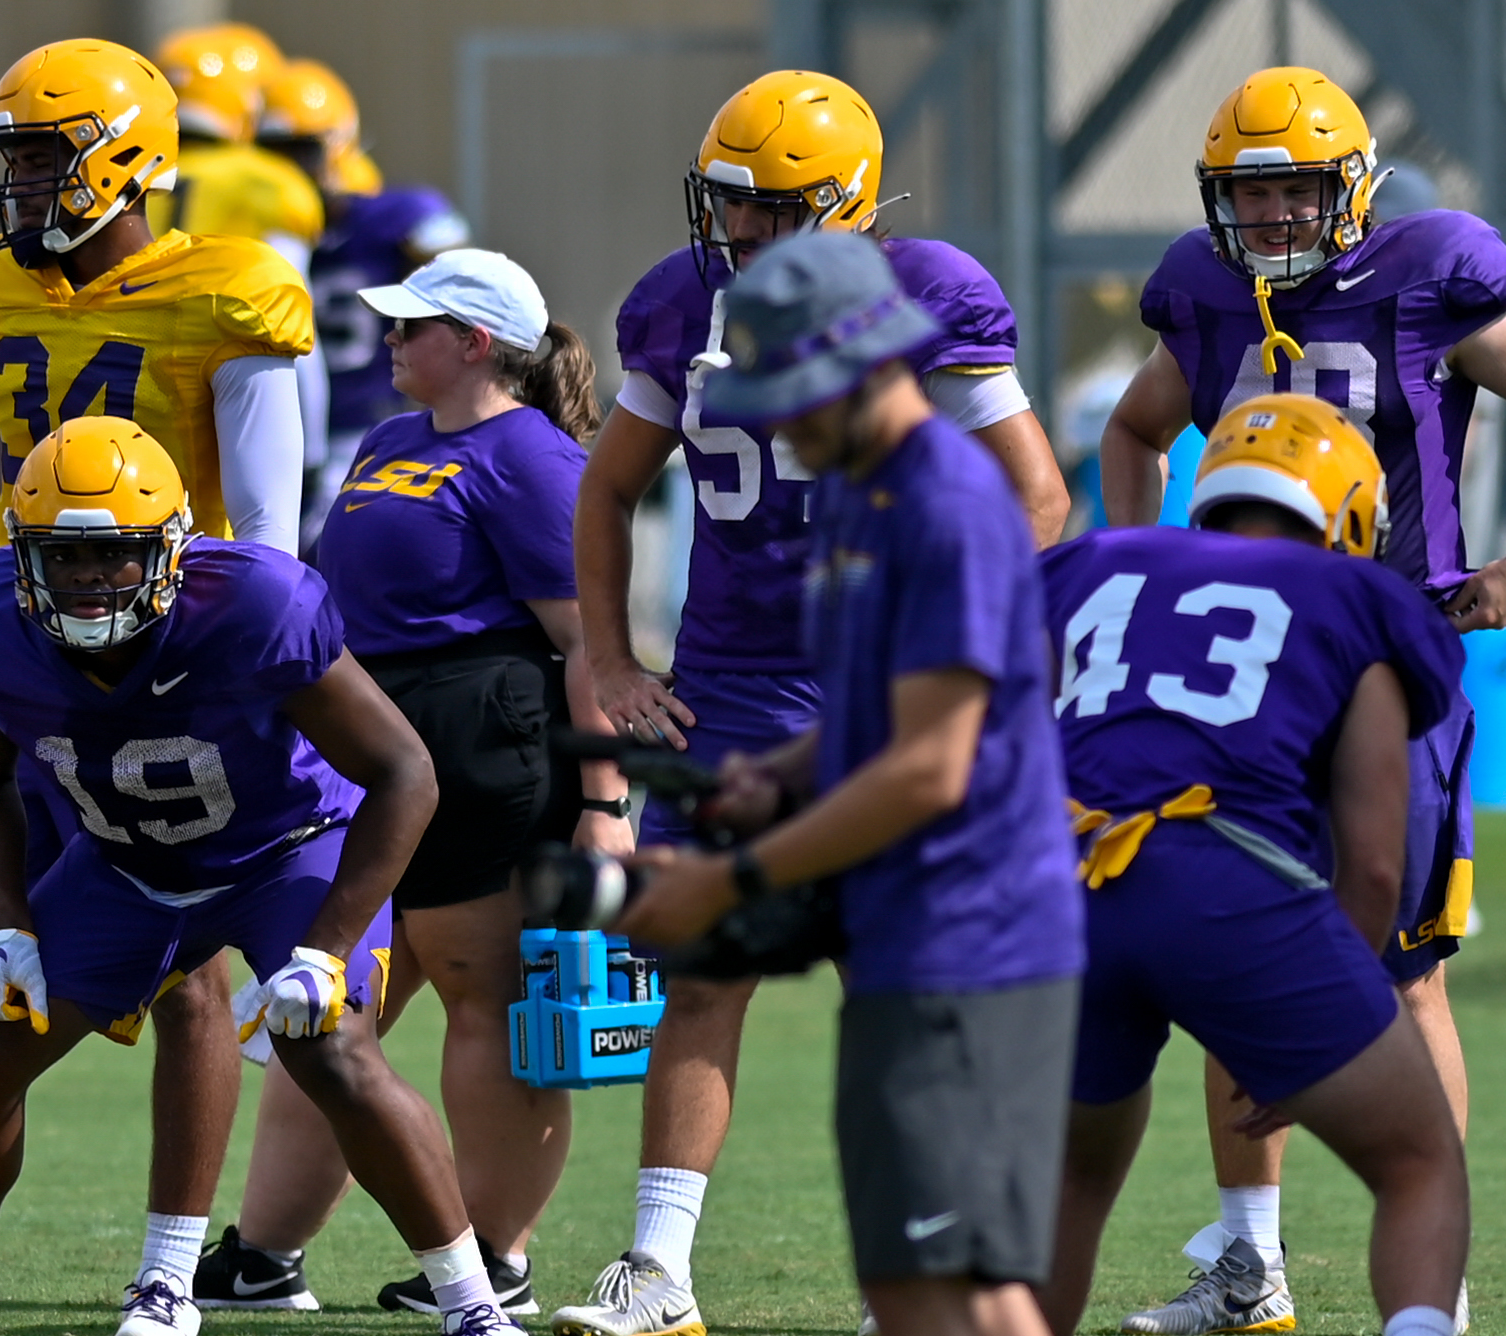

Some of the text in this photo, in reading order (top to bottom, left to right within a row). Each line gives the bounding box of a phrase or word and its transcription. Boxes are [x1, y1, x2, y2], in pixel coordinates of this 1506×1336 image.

[340, 454, 464, 498] LSU
[1053, 572, 1294, 727] 43
[35, 735, 237, 846] 19
[594, 1028, 657, 1053] POWE
